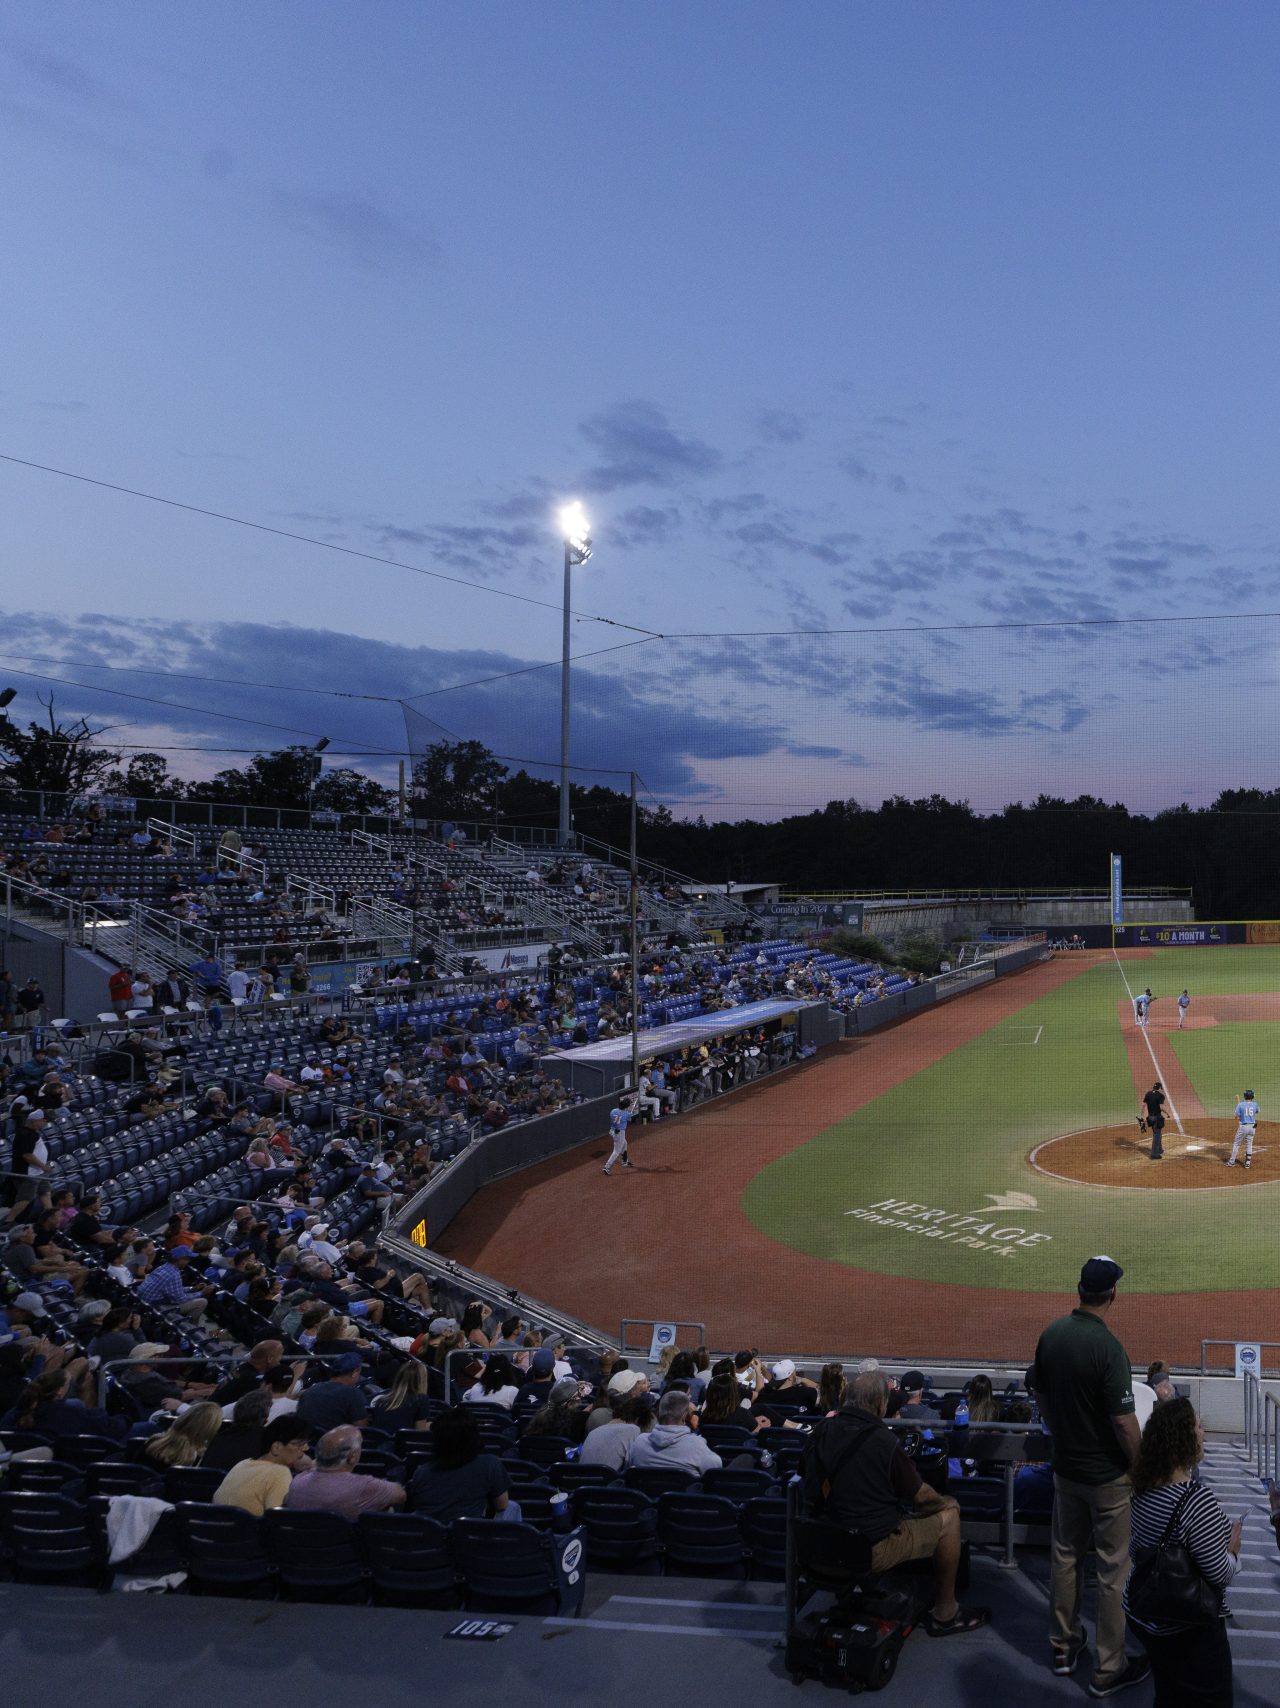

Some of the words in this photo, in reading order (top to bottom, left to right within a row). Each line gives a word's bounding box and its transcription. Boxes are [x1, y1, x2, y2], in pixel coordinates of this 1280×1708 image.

[1156, 932, 1170, 941] $10
[1172, 932, 1177, 940] A
[1179, 931, 1204, 940] MONTH
[1245, 1107, 1253, 1116] 16
[870, 1198, 1052, 1247] HERITAGE
[844, 1208, 958, 1240] Financial
[953, 1236, 1016, 1258] Park
[460, 1620, 508, 1636] 105
